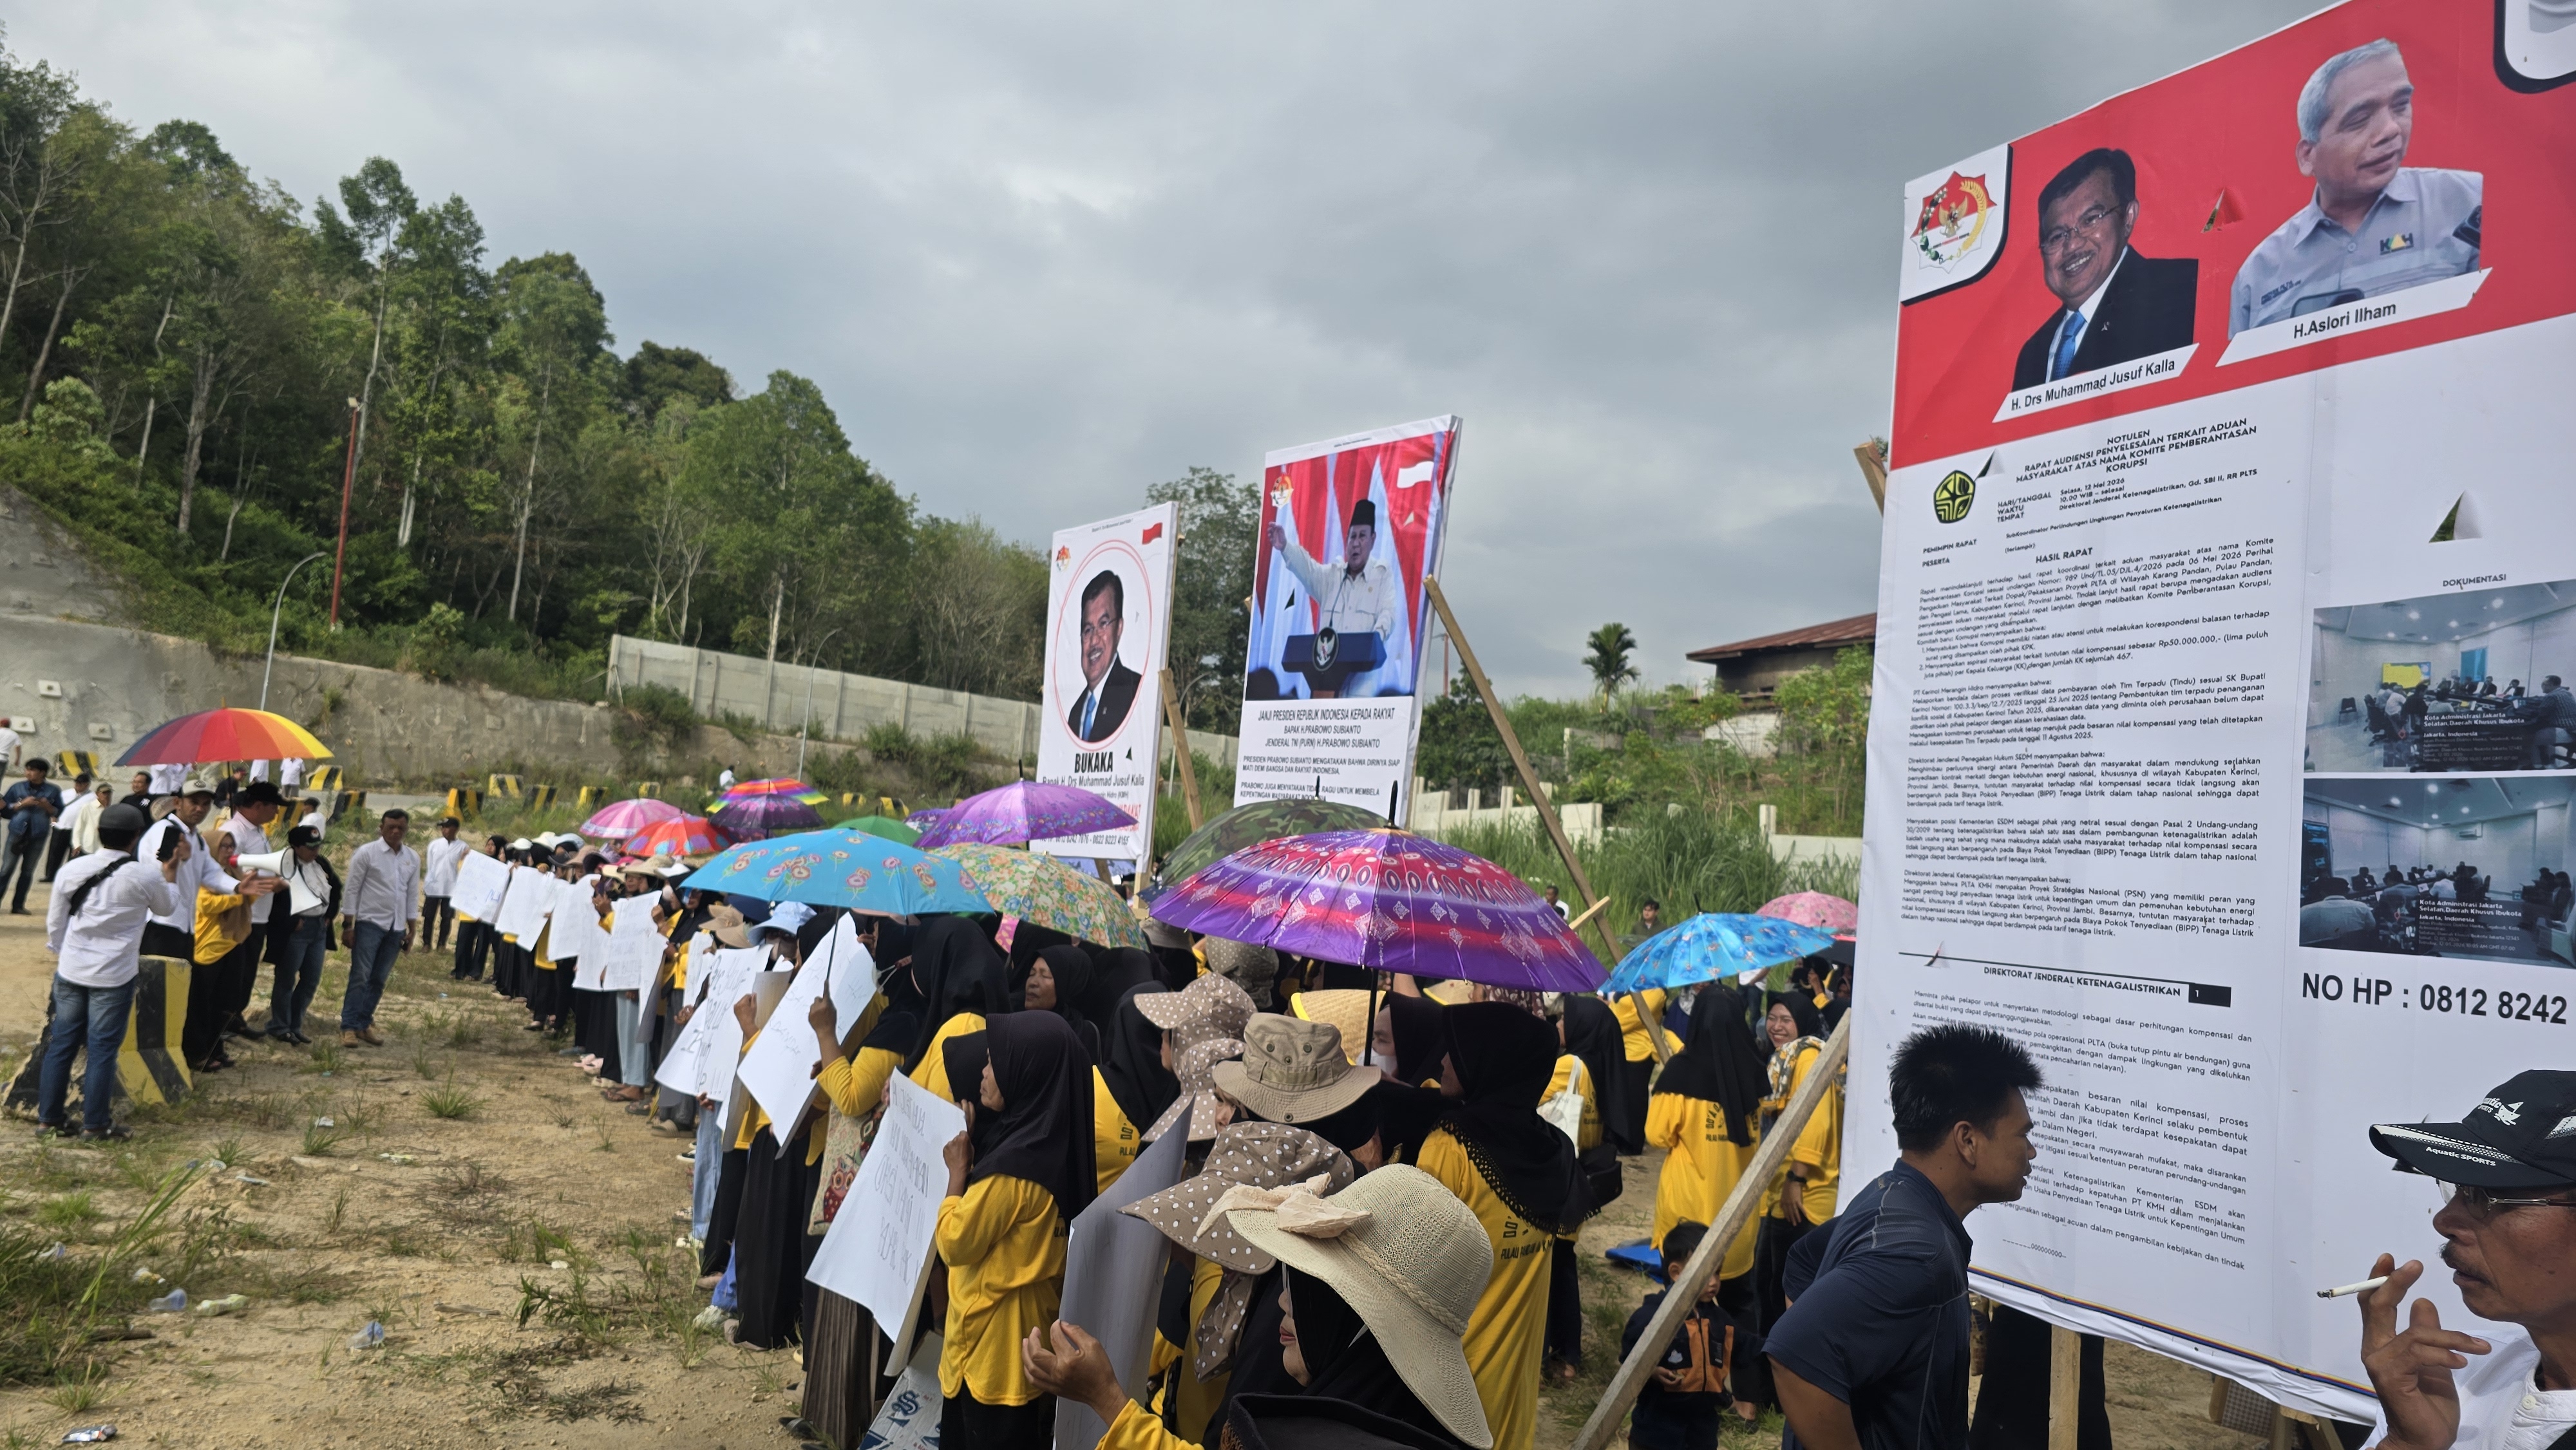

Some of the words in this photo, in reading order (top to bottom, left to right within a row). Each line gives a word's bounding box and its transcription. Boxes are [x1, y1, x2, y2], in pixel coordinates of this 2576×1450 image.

[2294, 312, 2349, 338] H.Aslori
[2354, 304, 2396, 323] Ilham
[2011, 398, 2020, 410] H.
[2025, 395, 2041, 407] Drs
[2045, 374, 2106, 401] Muhammad
[2109, 365, 2143, 385] Jusuf
[2145, 359, 2174, 376] Kalla
[2025, 460, 2050, 471] RAPAT
[2053, 451, 2093, 465] AUDIENSI
[2096, 435, 2163, 456] PENYELESAIAN
[2166, 426, 2206, 441] TERKAIT
[2209, 418, 2246, 433] ADUAN
[2107, 429, 2150, 444] NOTULEN
[2016, 464, 2072, 482] MASYARAKAT
[2075, 459, 2096, 469] ATAS
[2099, 453, 2126, 464] NAMA
[2130, 445, 2165, 458] KOMITE
[2168, 426, 2256, 451] PEMBERANTASAN
[2106, 458, 2147, 472] KORUPSI
[1997, 504, 2023, 514] WAKTU
[1998, 491, 2051, 507] HARI/TANGGAL
[1997, 511, 2023, 522] TEMPAT
[2036, 552, 2060, 563] HASIL
[2063, 547, 2092, 558] RAPAT
[2443, 574, 2506, 587] DOKUMENTASI
[1074, 751, 1113, 773] BUKAKA
[1113, 775, 1130, 786] Jusuf
[1984, 966, 2032, 979] DIREKTORAT
[2034, 972, 2074, 984] JENDERAL
[2077, 977, 2180, 996] KETENAGALISTRIKAN
[2302, 972, 2342, 1000] NO
[2353, 977, 2392, 1005] HP
[2420, 984, 2486, 1016] 0812
[2497, 991, 2566, 1024] 8242
[2053, 1097, 2079, 1109] Daerah
[2084, 1103, 2129, 1118] Kabupaten
[2134, 1112, 2163, 1125] Kerinci
[2167, 1120, 2193, 1131] selaku
[2198, 1126, 2248, 1141] pembentuk
[2088, 1091, 2121, 1104] besaran
[2130, 1099, 2146, 1108] nilai
[2157, 1102, 2209, 1121] kompensasi,
[2219, 1116, 2248, 1127] proses
[2097, 1119, 2117, 1129] tidak
[2122, 1124, 2158, 1137] terdapat
[2163, 1131, 2217, 1149] kesepakatan
[2222, 1144, 2246, 1155] dapat
[2426, 1147, 2459, 1158] Aquatic
[2461, 1154, 2496, 1166] SPORTS
[2132, 1197, 2141, 1205] PT
[2146, 1201, 2164, 1212] KMH
[2198, 1216, 2244, 1231] menjalankan
